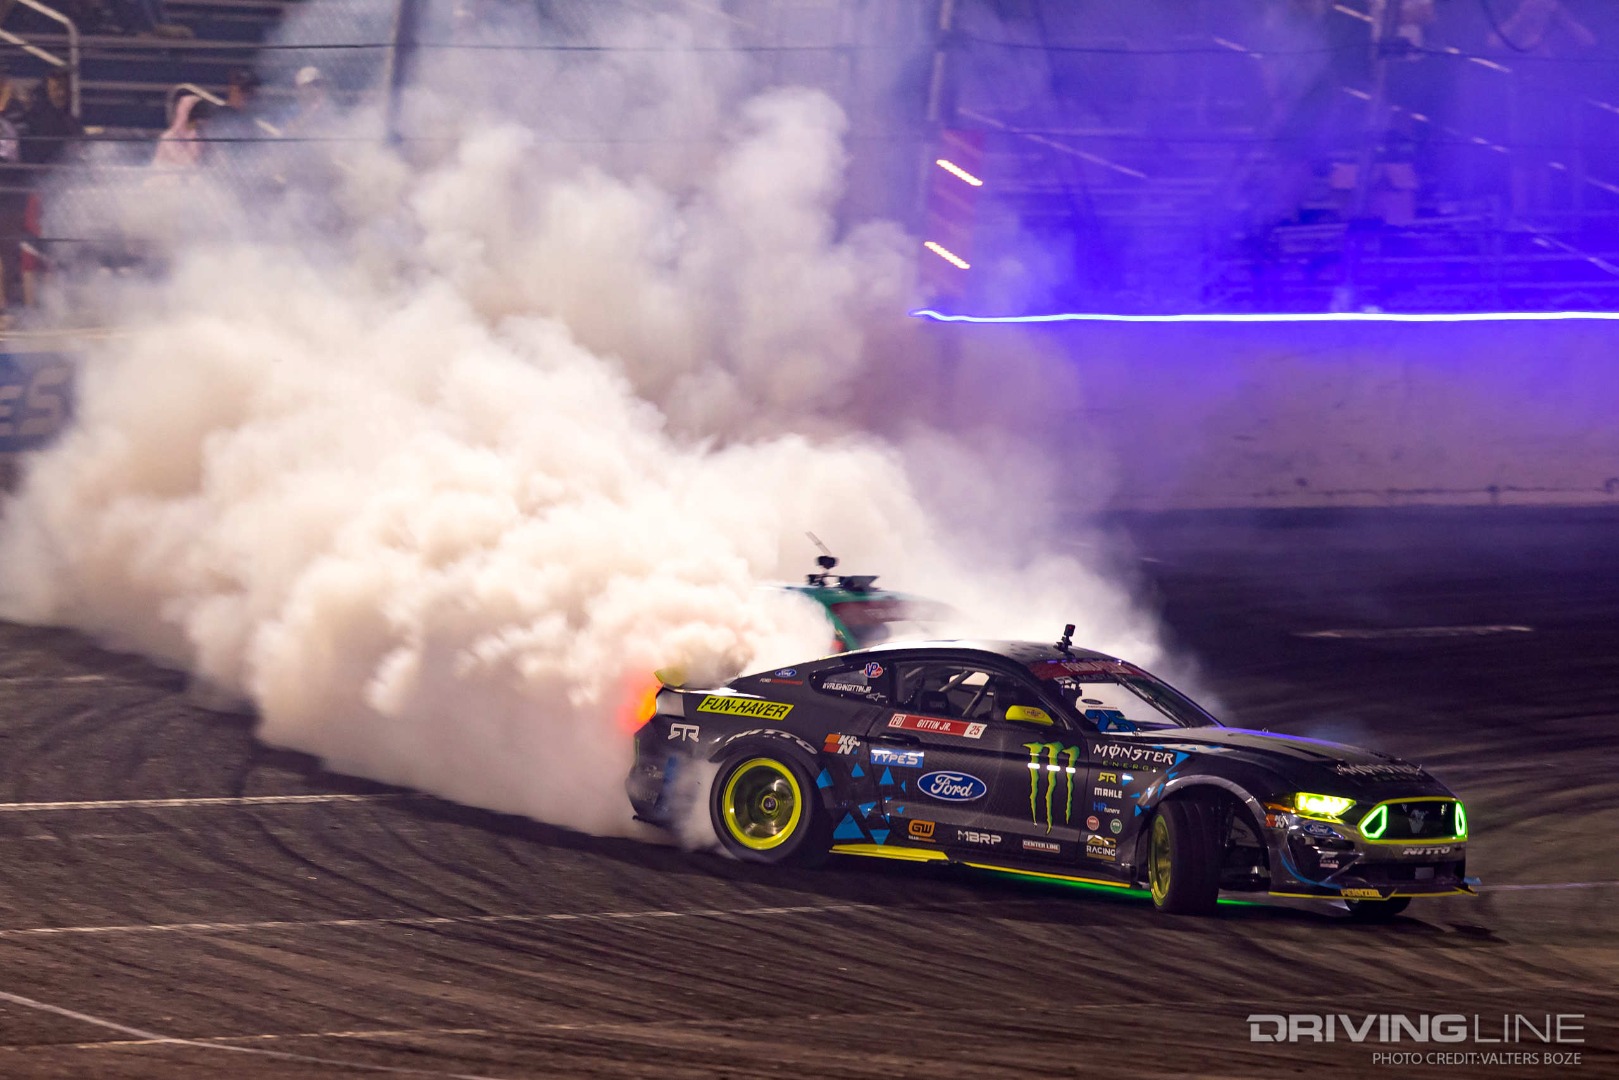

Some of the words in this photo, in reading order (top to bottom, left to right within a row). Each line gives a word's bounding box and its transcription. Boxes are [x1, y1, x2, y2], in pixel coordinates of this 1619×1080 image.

[702, 697, 789, 718] FUN-HAVER
[916, 719, 938, 730] GITTIN
[968, 725, 981, 736] 25
[1093, 744, 1174, 765] MONSTER
[1102, 760, 1159, 771] ENERGY
[930, 773, 973, 798] Ford
[1094, 787, 1123, 799] MAHLE
[957, 830, 1002, 845] MBRP
[1046, 843, 1060, 851] LINE
[1086, 845, 1116, 857] RACING
[1402, 846, 1451, 855] NITTO
